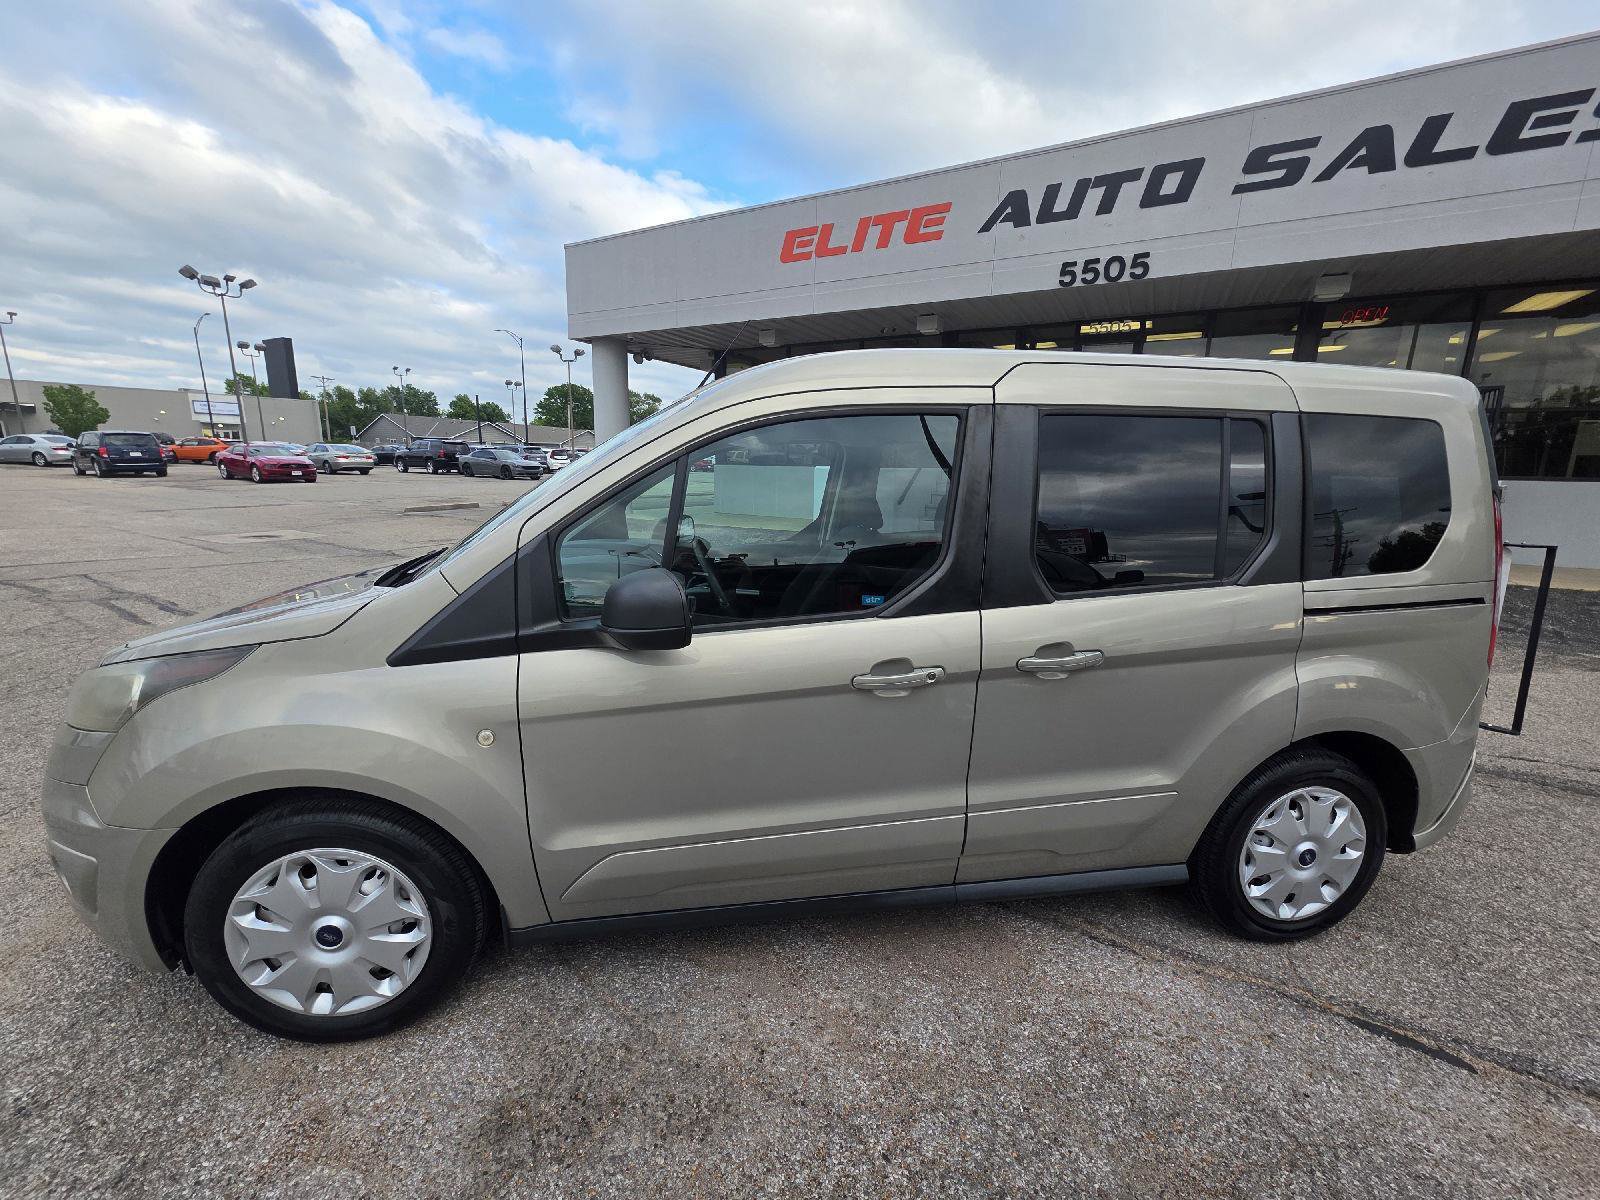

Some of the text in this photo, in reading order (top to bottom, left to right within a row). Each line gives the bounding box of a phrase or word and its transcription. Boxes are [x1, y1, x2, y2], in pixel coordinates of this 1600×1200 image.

[780, 87, 1600, 263] ELITE AUTO SALE
[1058, 251, 1151, 287] 5505
[1089, 319, 1133, 334] 5505
[1339, 305, 1390, 324] OPEN
